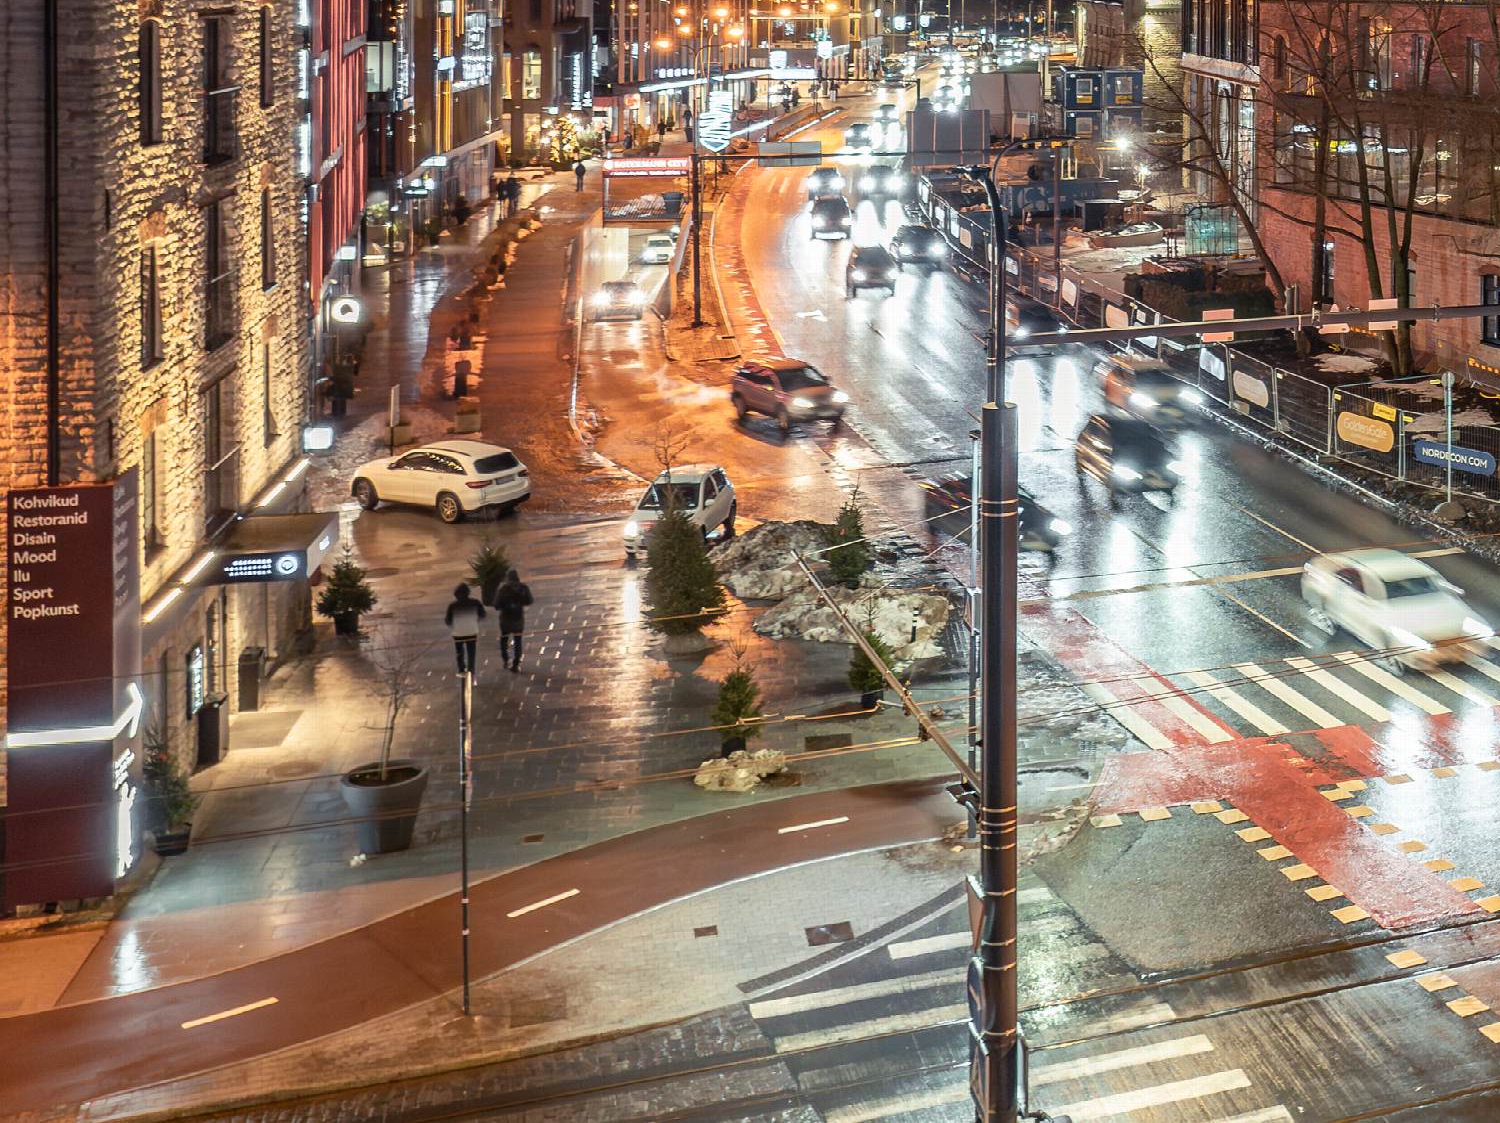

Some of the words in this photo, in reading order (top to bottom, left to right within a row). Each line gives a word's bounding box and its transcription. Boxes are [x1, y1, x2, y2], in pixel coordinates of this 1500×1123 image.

[1422, 447, 1488, 468] NORDECON.COM
[14, 494, 79, 510] Kohvikud
[14, 511, 88, 528] Restoranid
[14, 532, 56, 546] Disain
[14, 550, 57, 564] Mood
[14, 570, 30, 582] Ilu
[13, 588, 54, 602] Sport
[14, 604, 80, 620] Popkunst
